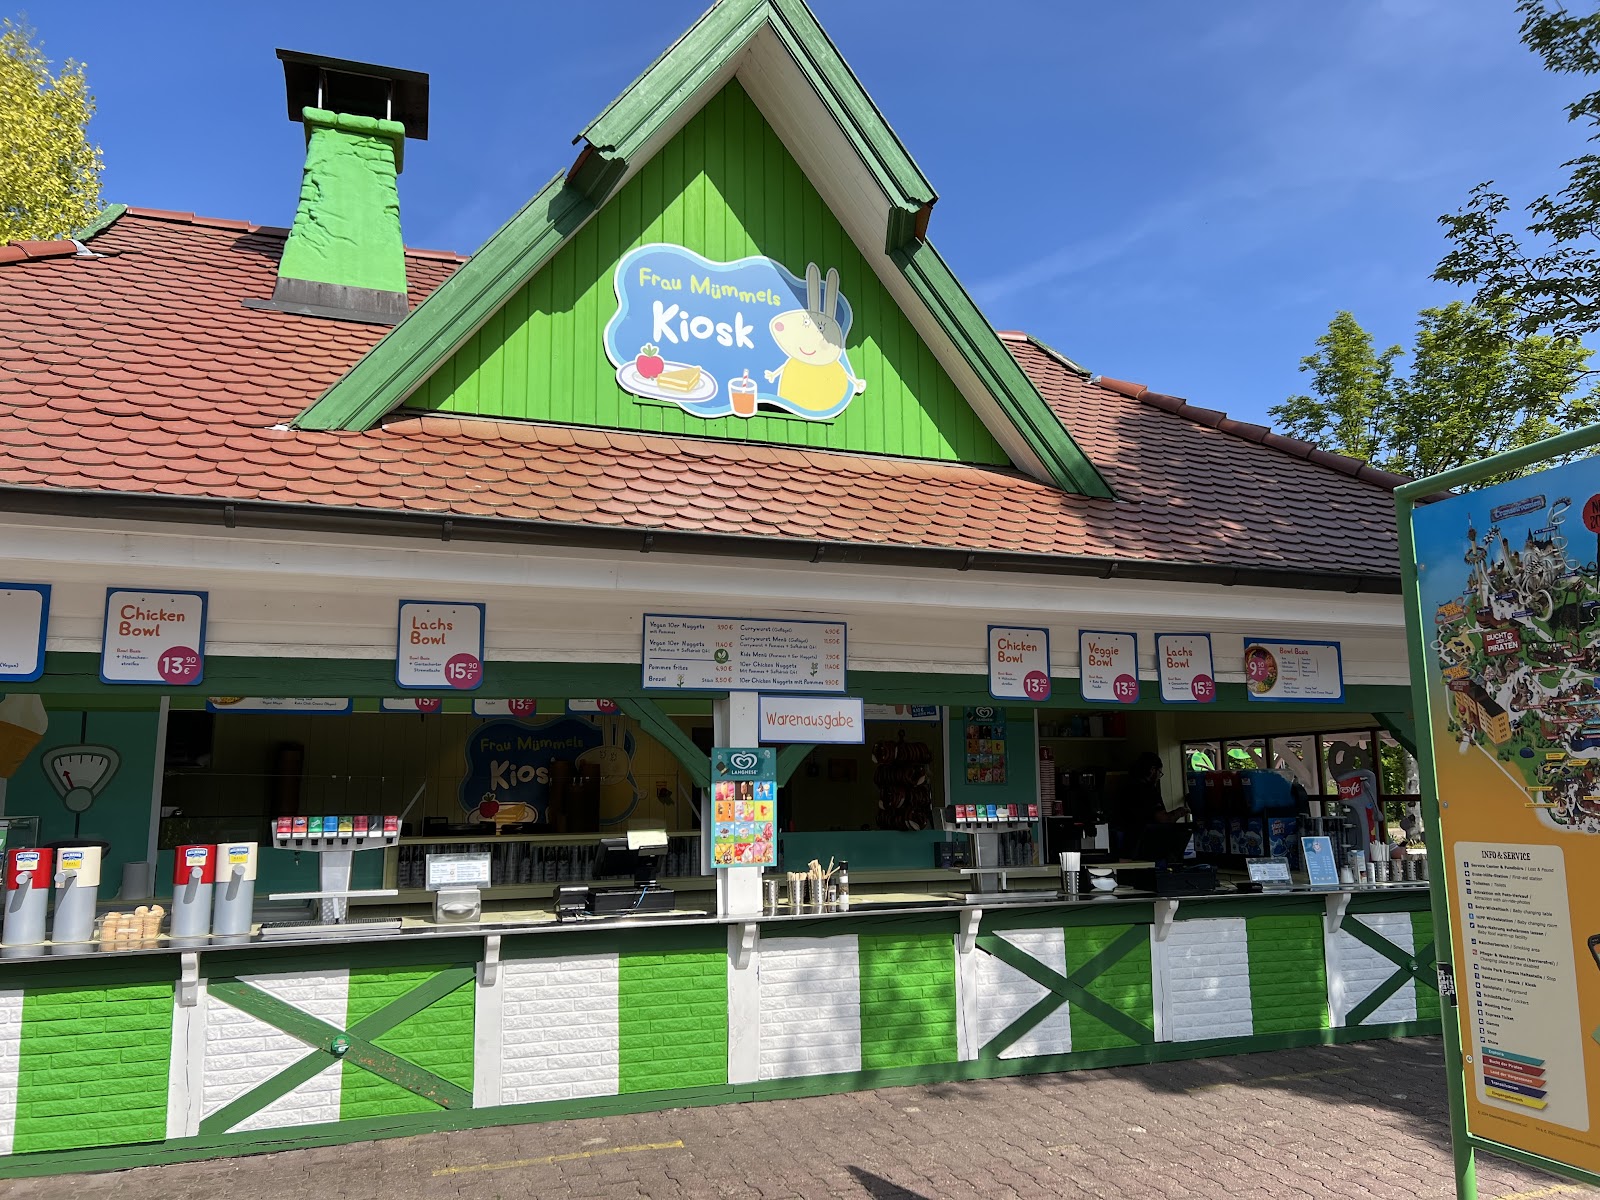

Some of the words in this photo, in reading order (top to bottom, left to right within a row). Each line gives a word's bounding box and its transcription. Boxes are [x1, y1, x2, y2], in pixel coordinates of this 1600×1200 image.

[639, 268, 681, 290] Frau
[690, 274, 781, 307] Mümmels
[652, 300, 754, 349] Kiosk
[121, 605, 185, 622] Chicken
[119, 621, 160, 637] Bowl
[413, 616, 453, 630] Lachs
[411, 631, 446, 644] Bowl
[1487, 632, 1507, 640] BUCHT
[998, 638, 1037, 652] Chicken
[1088, 643, 1119, 658] Veggie
[1166, 646, 1192, 657] Lachs
[1488, 641, 1518, 652] PIRATEN
[998, 651, 1023, 663] Bowl
[1089, 655, 1112, 666] Bowl
[1167, 658, 1189, 668] Bowl
[162, 657, 183, 674] 13
[449, 663, 466, 679] 15
[1250, 662, 1257, 675] 9
[1026, 679, 1039, 692] 13
[1116, 682, 1128, 695] 13
[1193, 682, 1205, 695] 15
[766, 711, 854, 729] Warenausgabe
[480, 738, 511, 752] Frau
[517, 736, 583, 751] Mümmels
[490, 759, 552, 791] Kios
[1482, 851, 1496, 859] INFO
[1504, 852, 1531, 860] SERVICE
